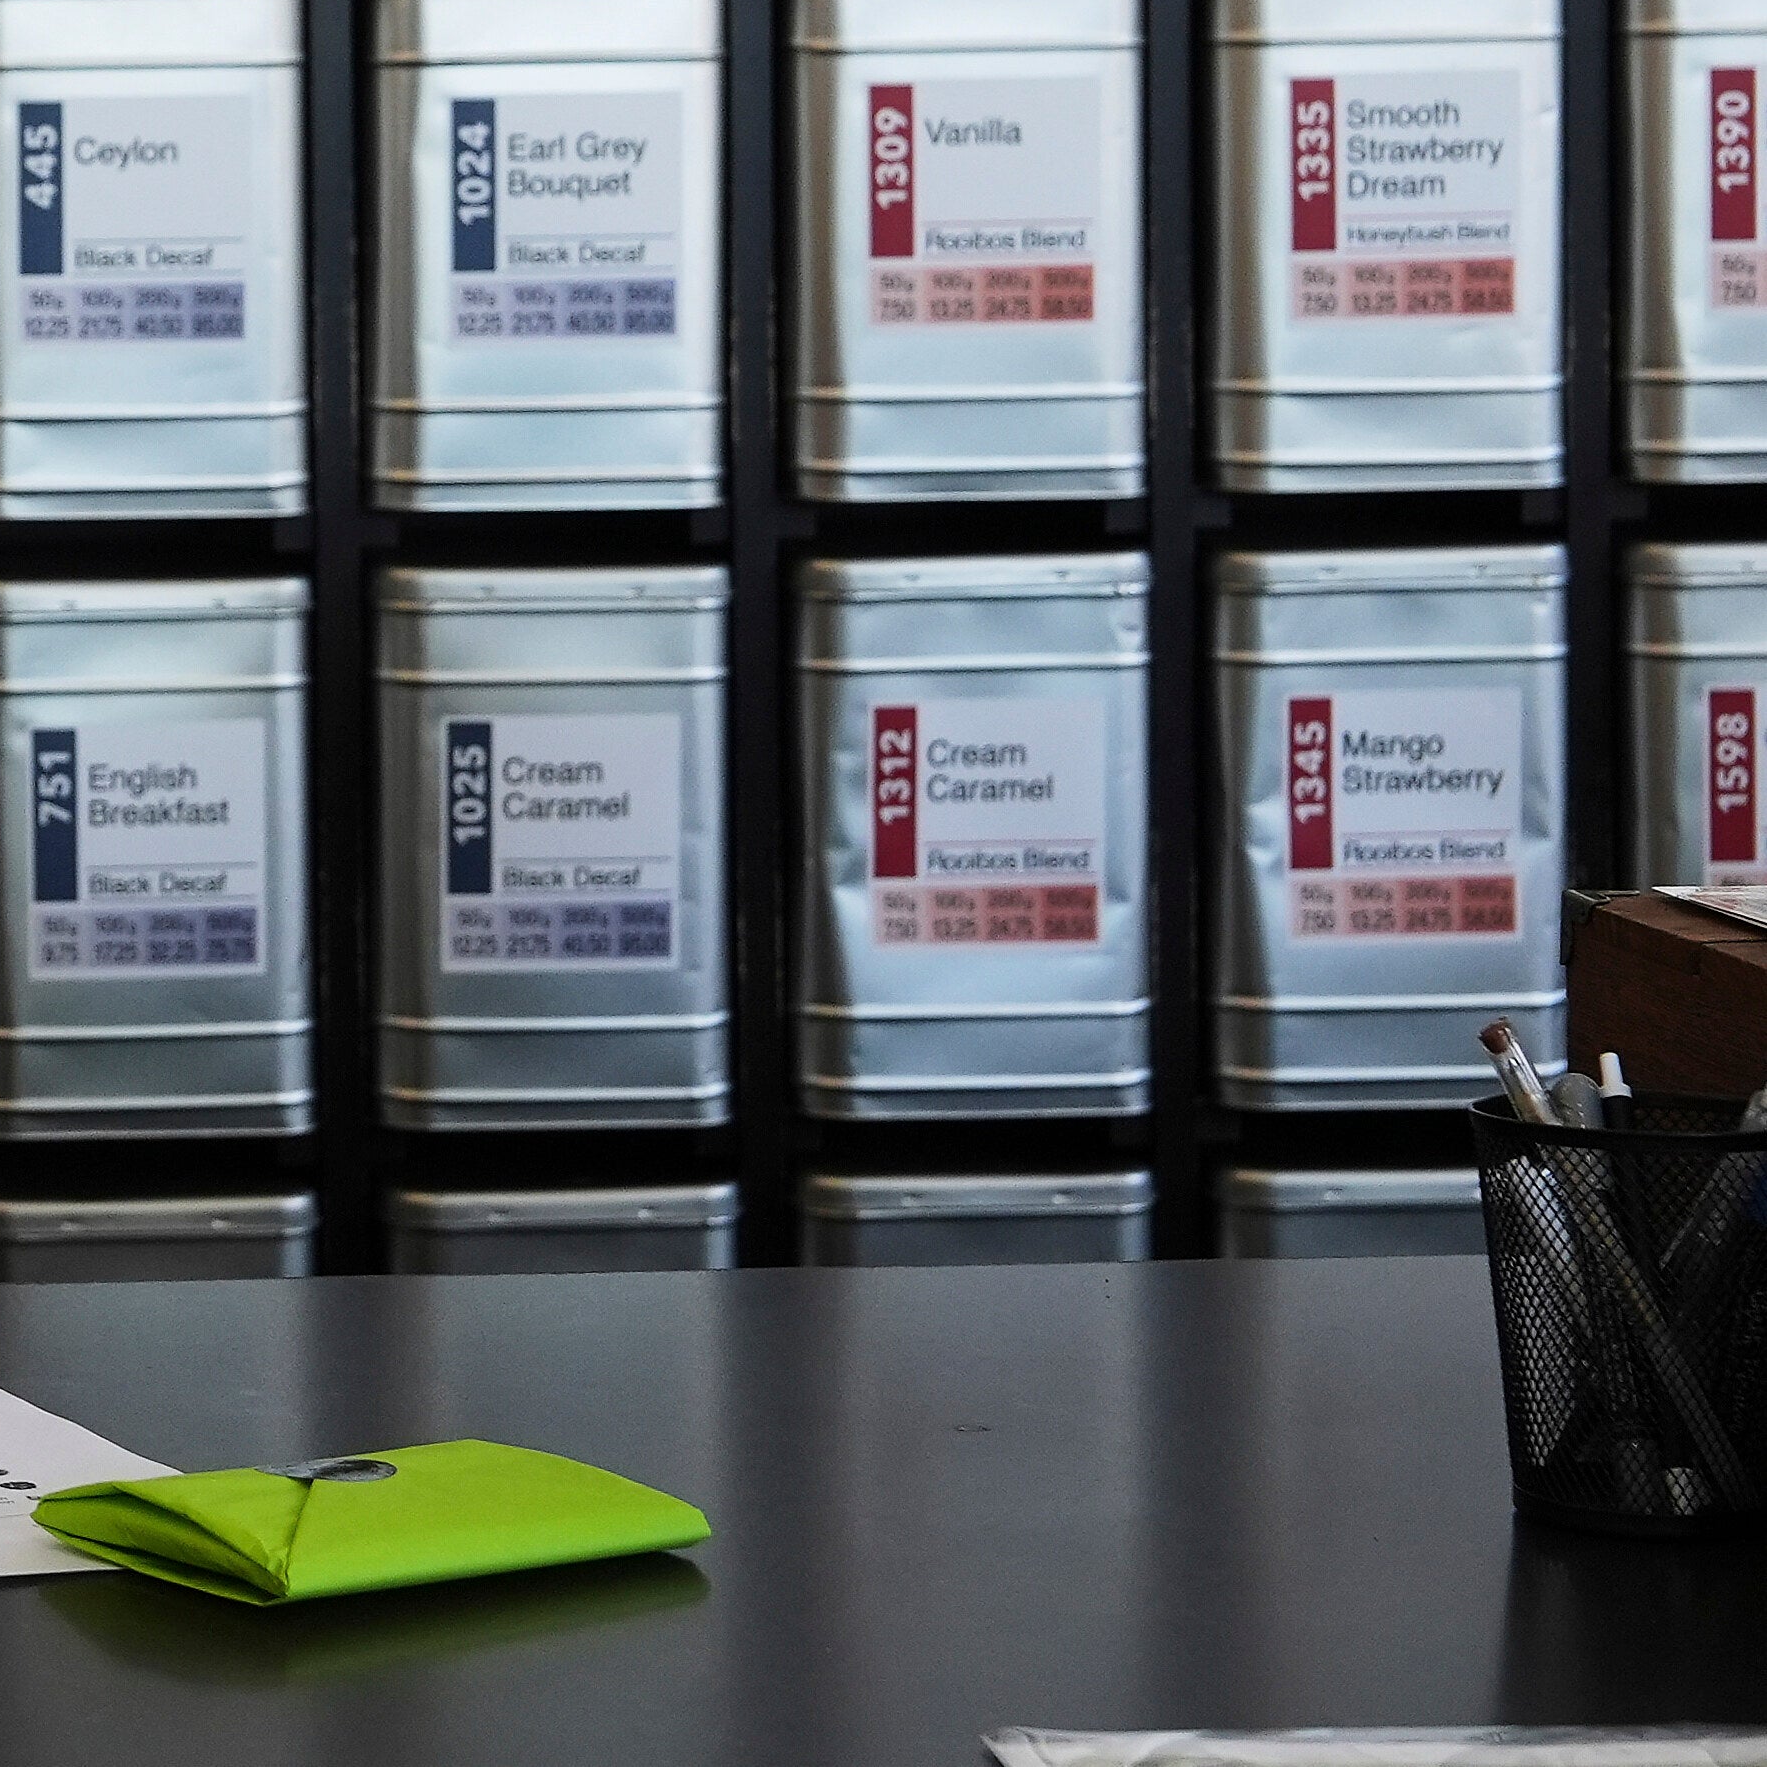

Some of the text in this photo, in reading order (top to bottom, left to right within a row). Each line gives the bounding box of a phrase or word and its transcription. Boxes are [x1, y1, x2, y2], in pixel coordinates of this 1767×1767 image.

[1346, 99, 1460, 130] Smooth
[925, 118, 1022, 147] Vanilla
[73, 136, 178, 171] Ceylon
[507, 131, 647, 166] Earl Grey
[874, 107, 908, 208] 1309
[1347, 135, 1503, 166] Strawberry
[24, 125, 58, 209] 445
[507, 169, 632, 201] Bouquet
[1347, 170, 1446, 200] Dream
[508, 240, 645, 266] Black Decaf
[926, 738, 1027, 769] Cream
[1342, 730, 1445, 764] Mango
[88, 763, 198, 800] English
[501, 756, 604, 787] Cream
[1294, 721, 1326, 824] 1345
[1343, 765, 1504, 798] Strawberry
[452, 745, 487, 844] 1025
[926, 774, 1054, 803] Caramel
[88, 797, 230, 828] Breakfast
[502, 791, 630, 821] Caramel
